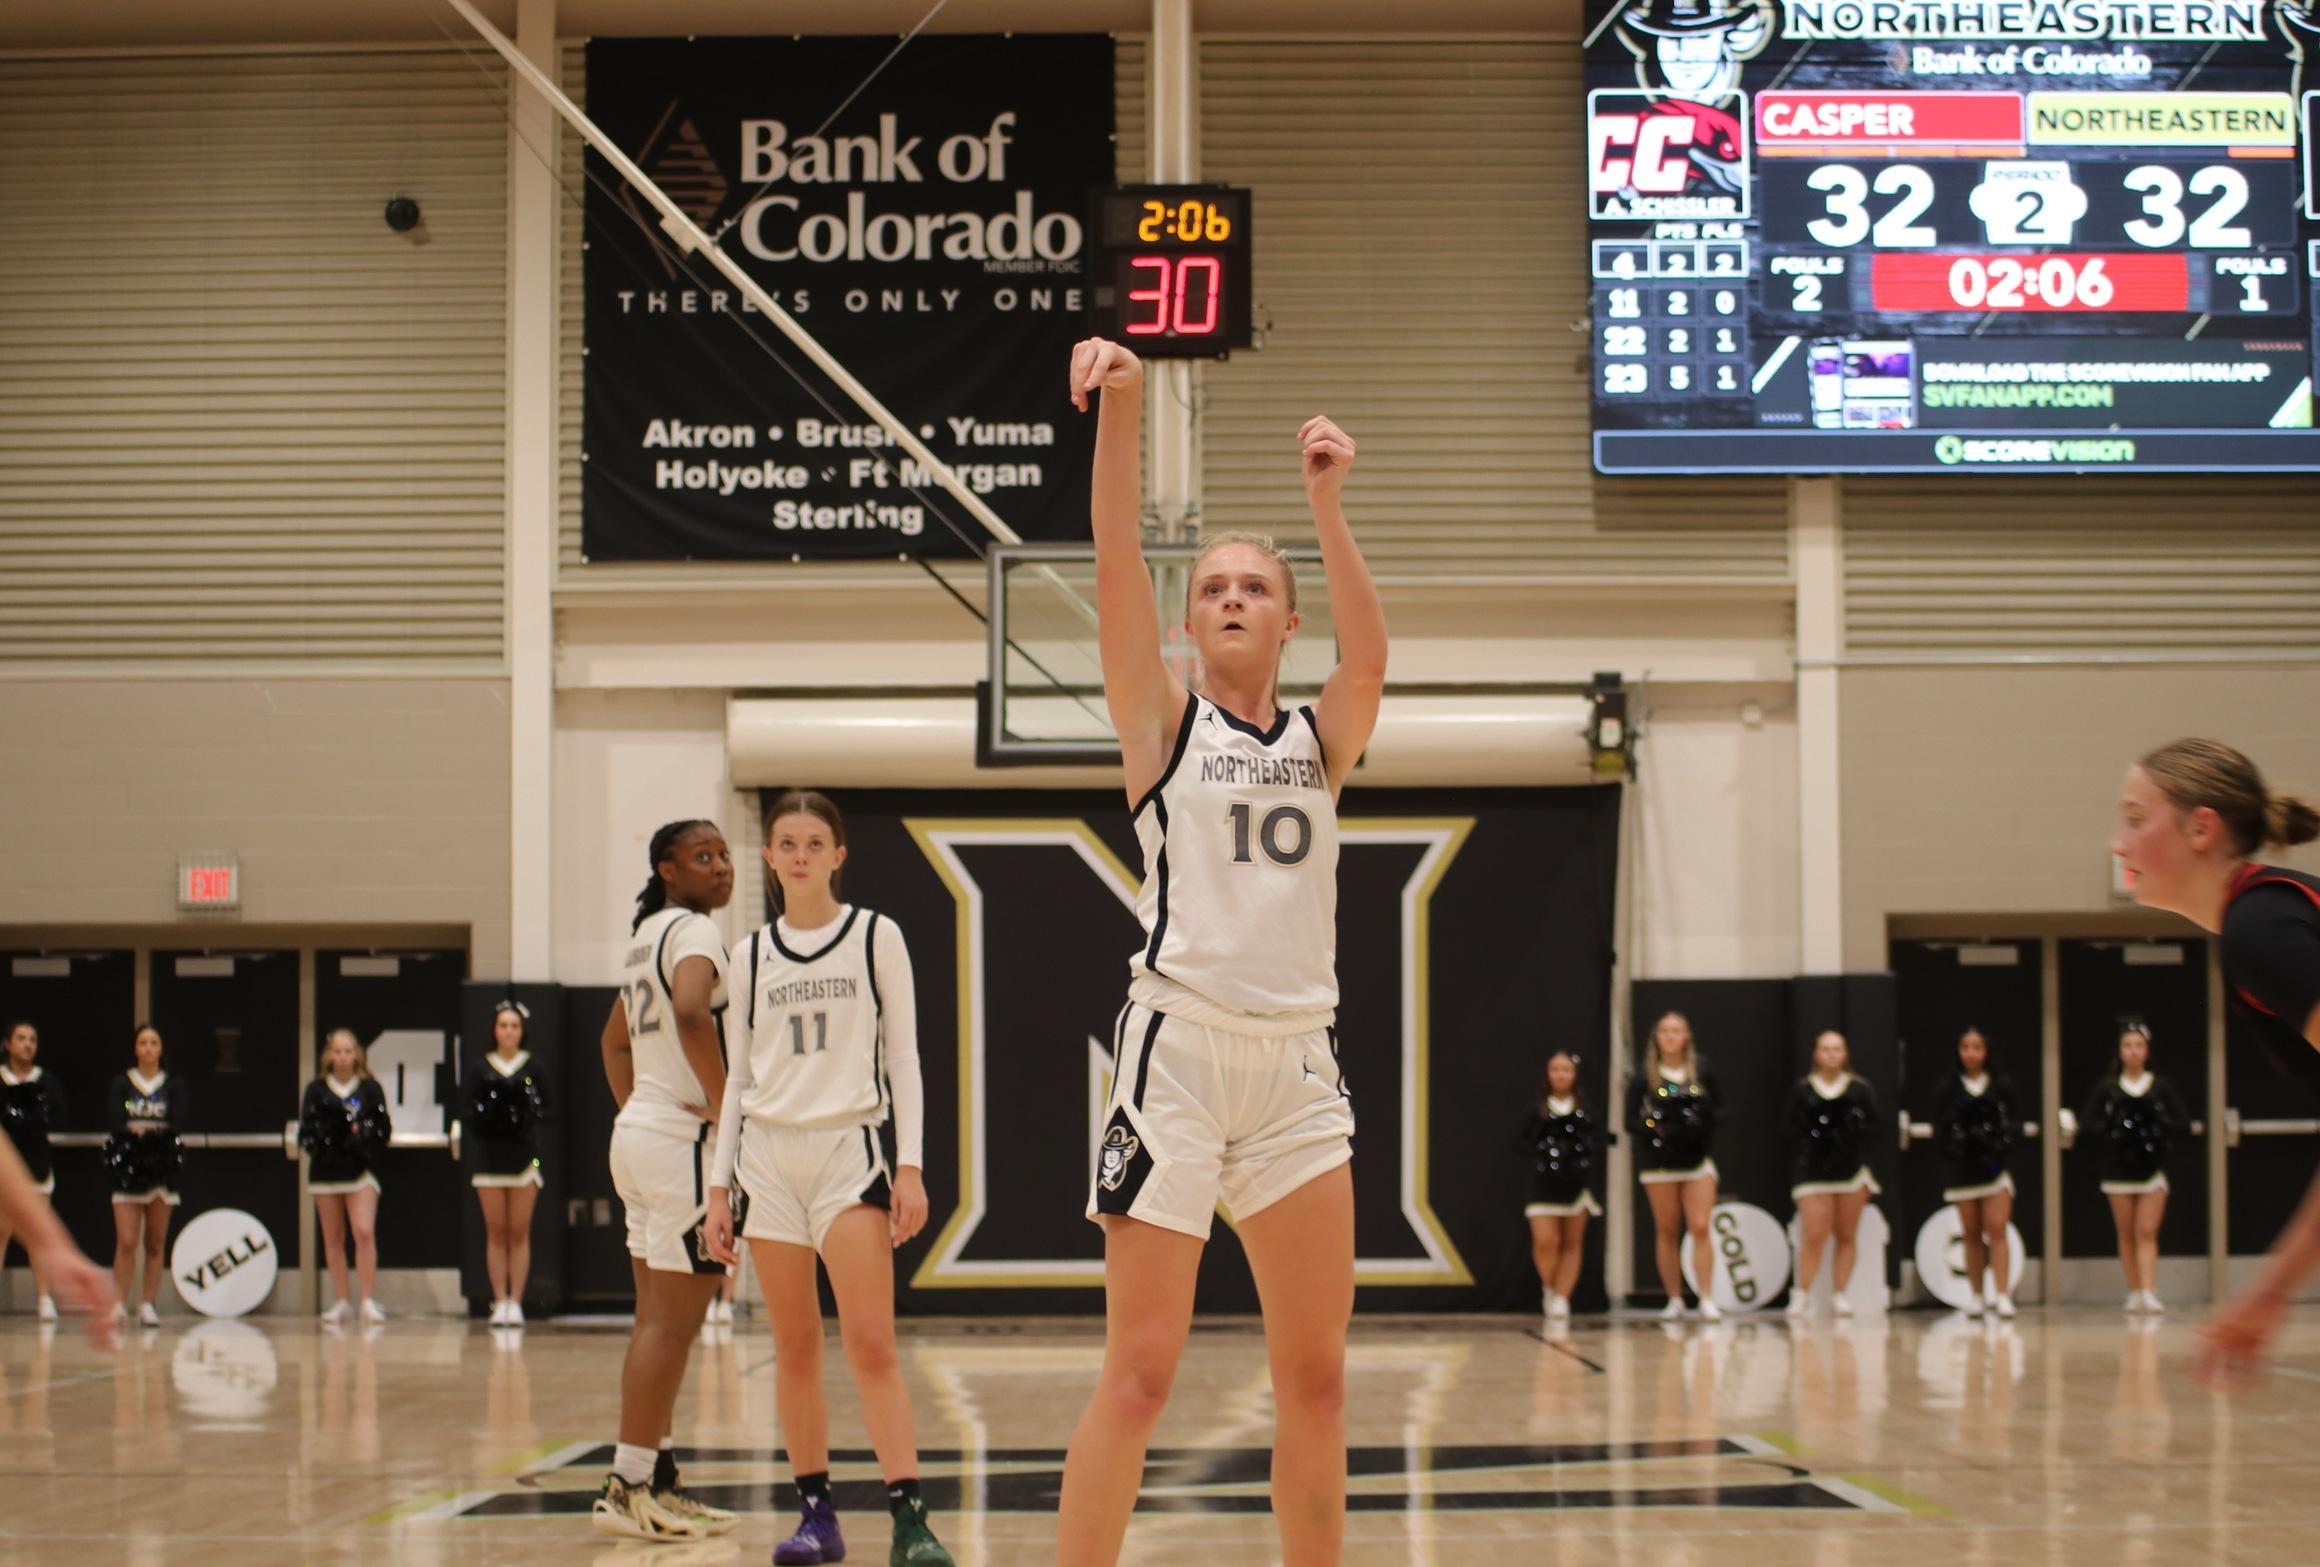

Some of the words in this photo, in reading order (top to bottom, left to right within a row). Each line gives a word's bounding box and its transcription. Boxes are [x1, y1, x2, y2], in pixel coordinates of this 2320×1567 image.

[1783, 0, 2267, 40] NORTHEASTERN
[1912, 46, 1984, 74] Bank
[1986, 45, 2018, 74] of
[2022, 46, 2151, 75] Colorado
[1763, 103, 1915, 136] CASPER
[2036, 108, 2287, 132] NORTHEASTERN
[741, 113, 923, 184] Bank
[938, 111, 1016, 183] of
[1138, 200, 1231, 242] 2:06
[1806, 164, 1936, 247] 32
[2015, 191, 2045, 233] 2
[2122, 164, 2250, 247] 32
[740, 190, 1082, 262] Colorado
[1668, 253, 1687, 275] 2
[1715, 253, 1734, 275] 2
[1949, 258, 2114, 307] 02:06
[2215, 257, 2288, 276] FOULS
[845, 288, 960, 313] ONLY
[993, 288, 1082, 312] ONE
[1126, 257, 1220, 334] 30
[1608, 288, 1641, 319] 11
[1668, 291, 1688, 315] 2
[1715, 290, 1735, 314] 0
[1792, 275, 1823, 313] 2
[2239, 275, 2269, 312] 1
[1604, 326, 1648, 356] 22
[1668, 328, 1689, 353] 2
[1716, 328, 1736, 353] 1
[1670, 365, 1689, 391] 5
[1717, 365, 1736, 391] 1
[1923, 383, 2114, 408] SVFANAPP.COM
[642, 418, 757, 448] Akron
[946, 416, 1055, 447] Yuma
[656, 459, 810, 496] Holyoke
[850, 458, 889, 489] Ft
[772, 500, 924, 536] Sterling
[1201, 755, 1326, 792] NORTHEASTERN
[1226, 801, 1315, 869] 10
[190, 868, 231, 901] EXIT
[767, 978, 857, 1009] NORTHEASTERN
[788, 1011, 828, 1056] 11
[183, 1235, 269, 1290] YELL
